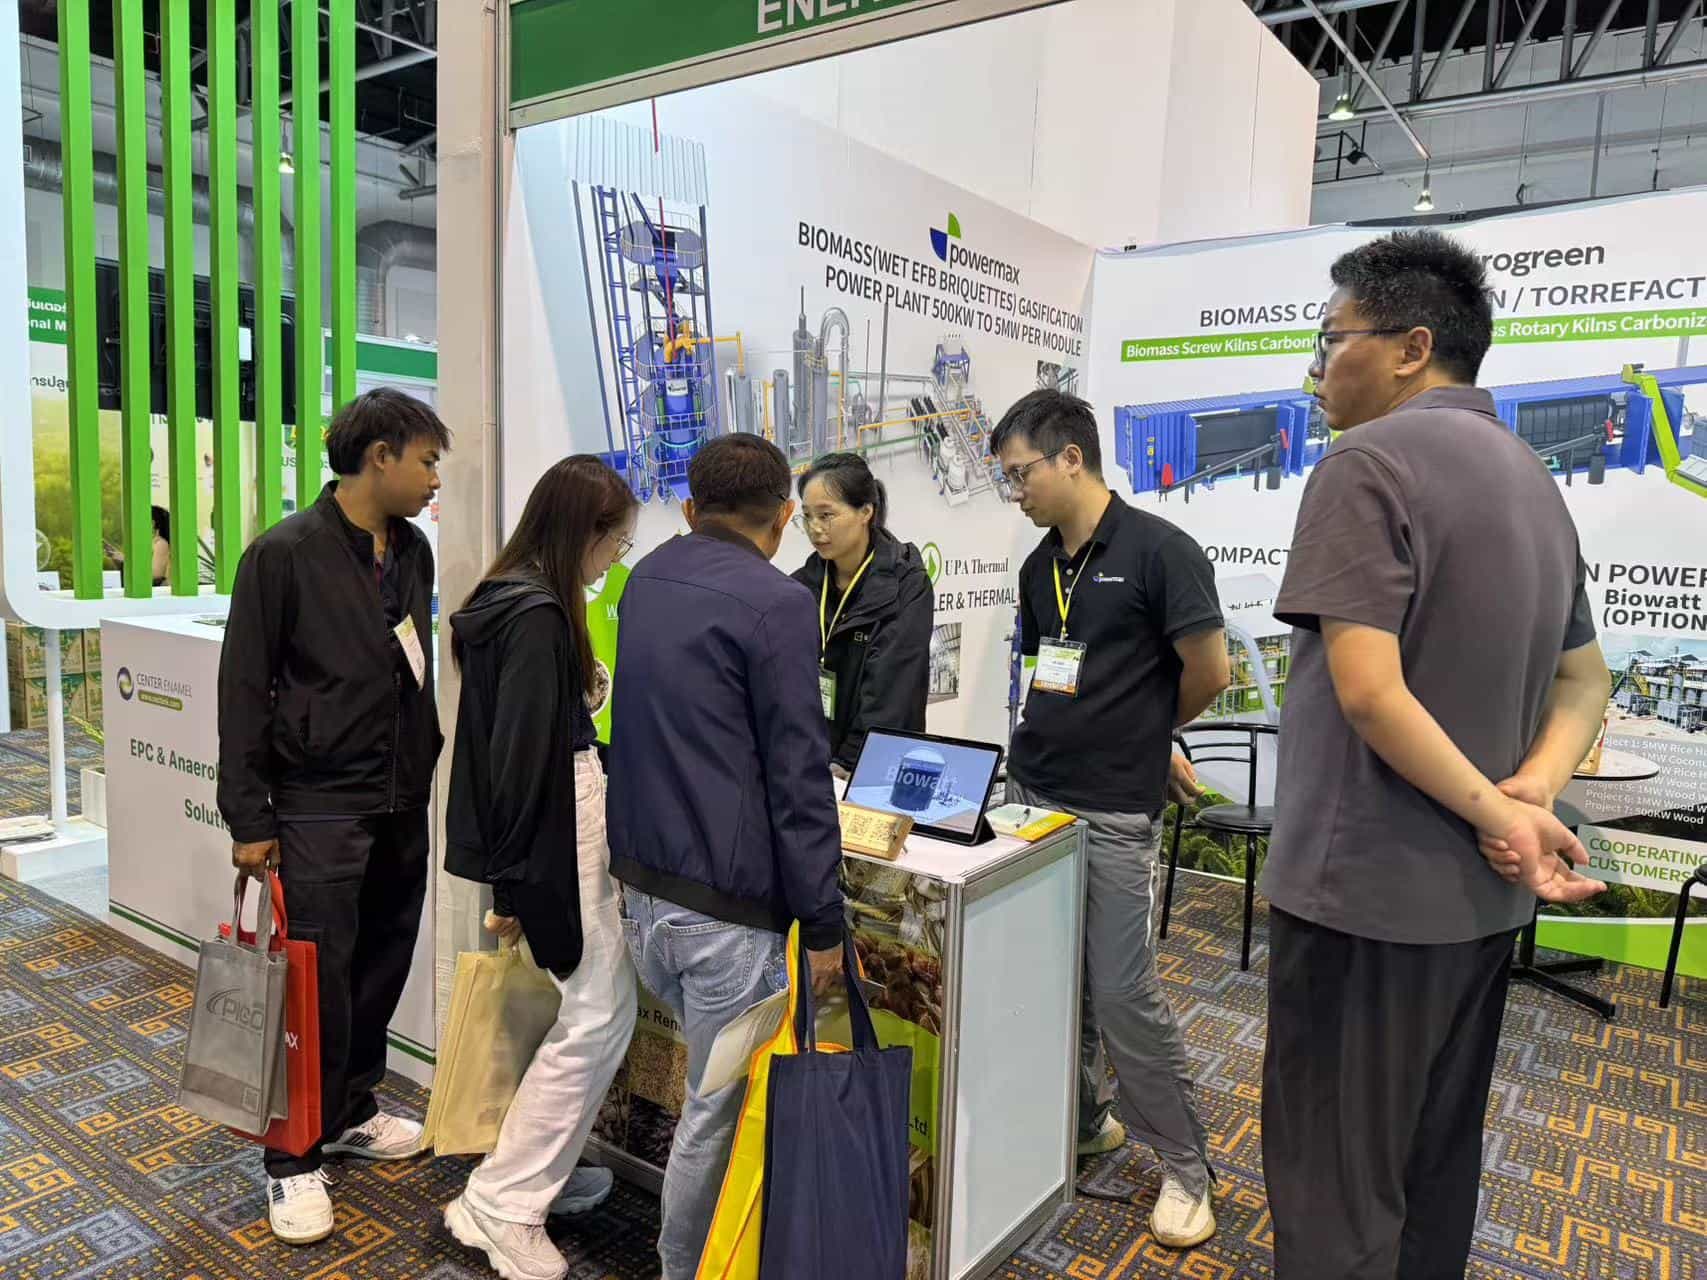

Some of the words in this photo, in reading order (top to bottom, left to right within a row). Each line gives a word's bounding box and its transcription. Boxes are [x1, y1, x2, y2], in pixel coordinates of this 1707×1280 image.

[950, 243, 1020, 286] powermax
[911, 262, 937, 288] EFB
[939, 269, 1017, 315] BRIQUETTES)
[1018, 298, 1083, 333] GASIFICATION
[1531, 276, 1707, 308] TORREFACT
[826, 265, 882, 301] POWER
[886, 283, 930, 312] PLANT
[932, 298, 974, 329] 500KW
[977, 312, 993, 333] TO
[995, 317, 1020, 341] 5MW
[1022, 325, 1042, 346] PER
[1042, 331, 1081, 357] MODULE
[1200, 304, 1297, 328] BIOMASS
[28, 319, 51, 330] nal
[1510, 321, 1568, 338] Rotary
[1572, 317, 1617, 334] Kilns
[1127, 343, 1181, 359] Biomass
[1182, 341, 1222, 356] Screw
[1224, 338, 1257, 352] Kilns
[1260, 334, 1317, 351] Carboni
[945, 560, 969, 576] UPA
[971, 558, 1008, 574] Thermal
[956, 592, 965, 610] &
[968, 587, 1016, 609] THERMAL
[1605, 588, 1701, 610] Biowatt
[1604, 607, 1707, 631] (OPTION
[137, 672, 162, 689] CENTER
[130, 739, 154, 762] EPC
[156, 747, 166, 765] &
[1670, 743, 1693, 754] Rice
[1674, 768, 1696, 778] Rice
[1586, 789, 1624, 801] Project
[1663, 800, 1695, 812] Wood
[1665, 789, 1696, 801] Wood
[1585, 800, 1621, 813] Project
[1635, 808, 1671, 820] 500KW
[1672, 812, 1704, 825] Wood
[1588, 856, 1691, 883] CUSTOMERS
